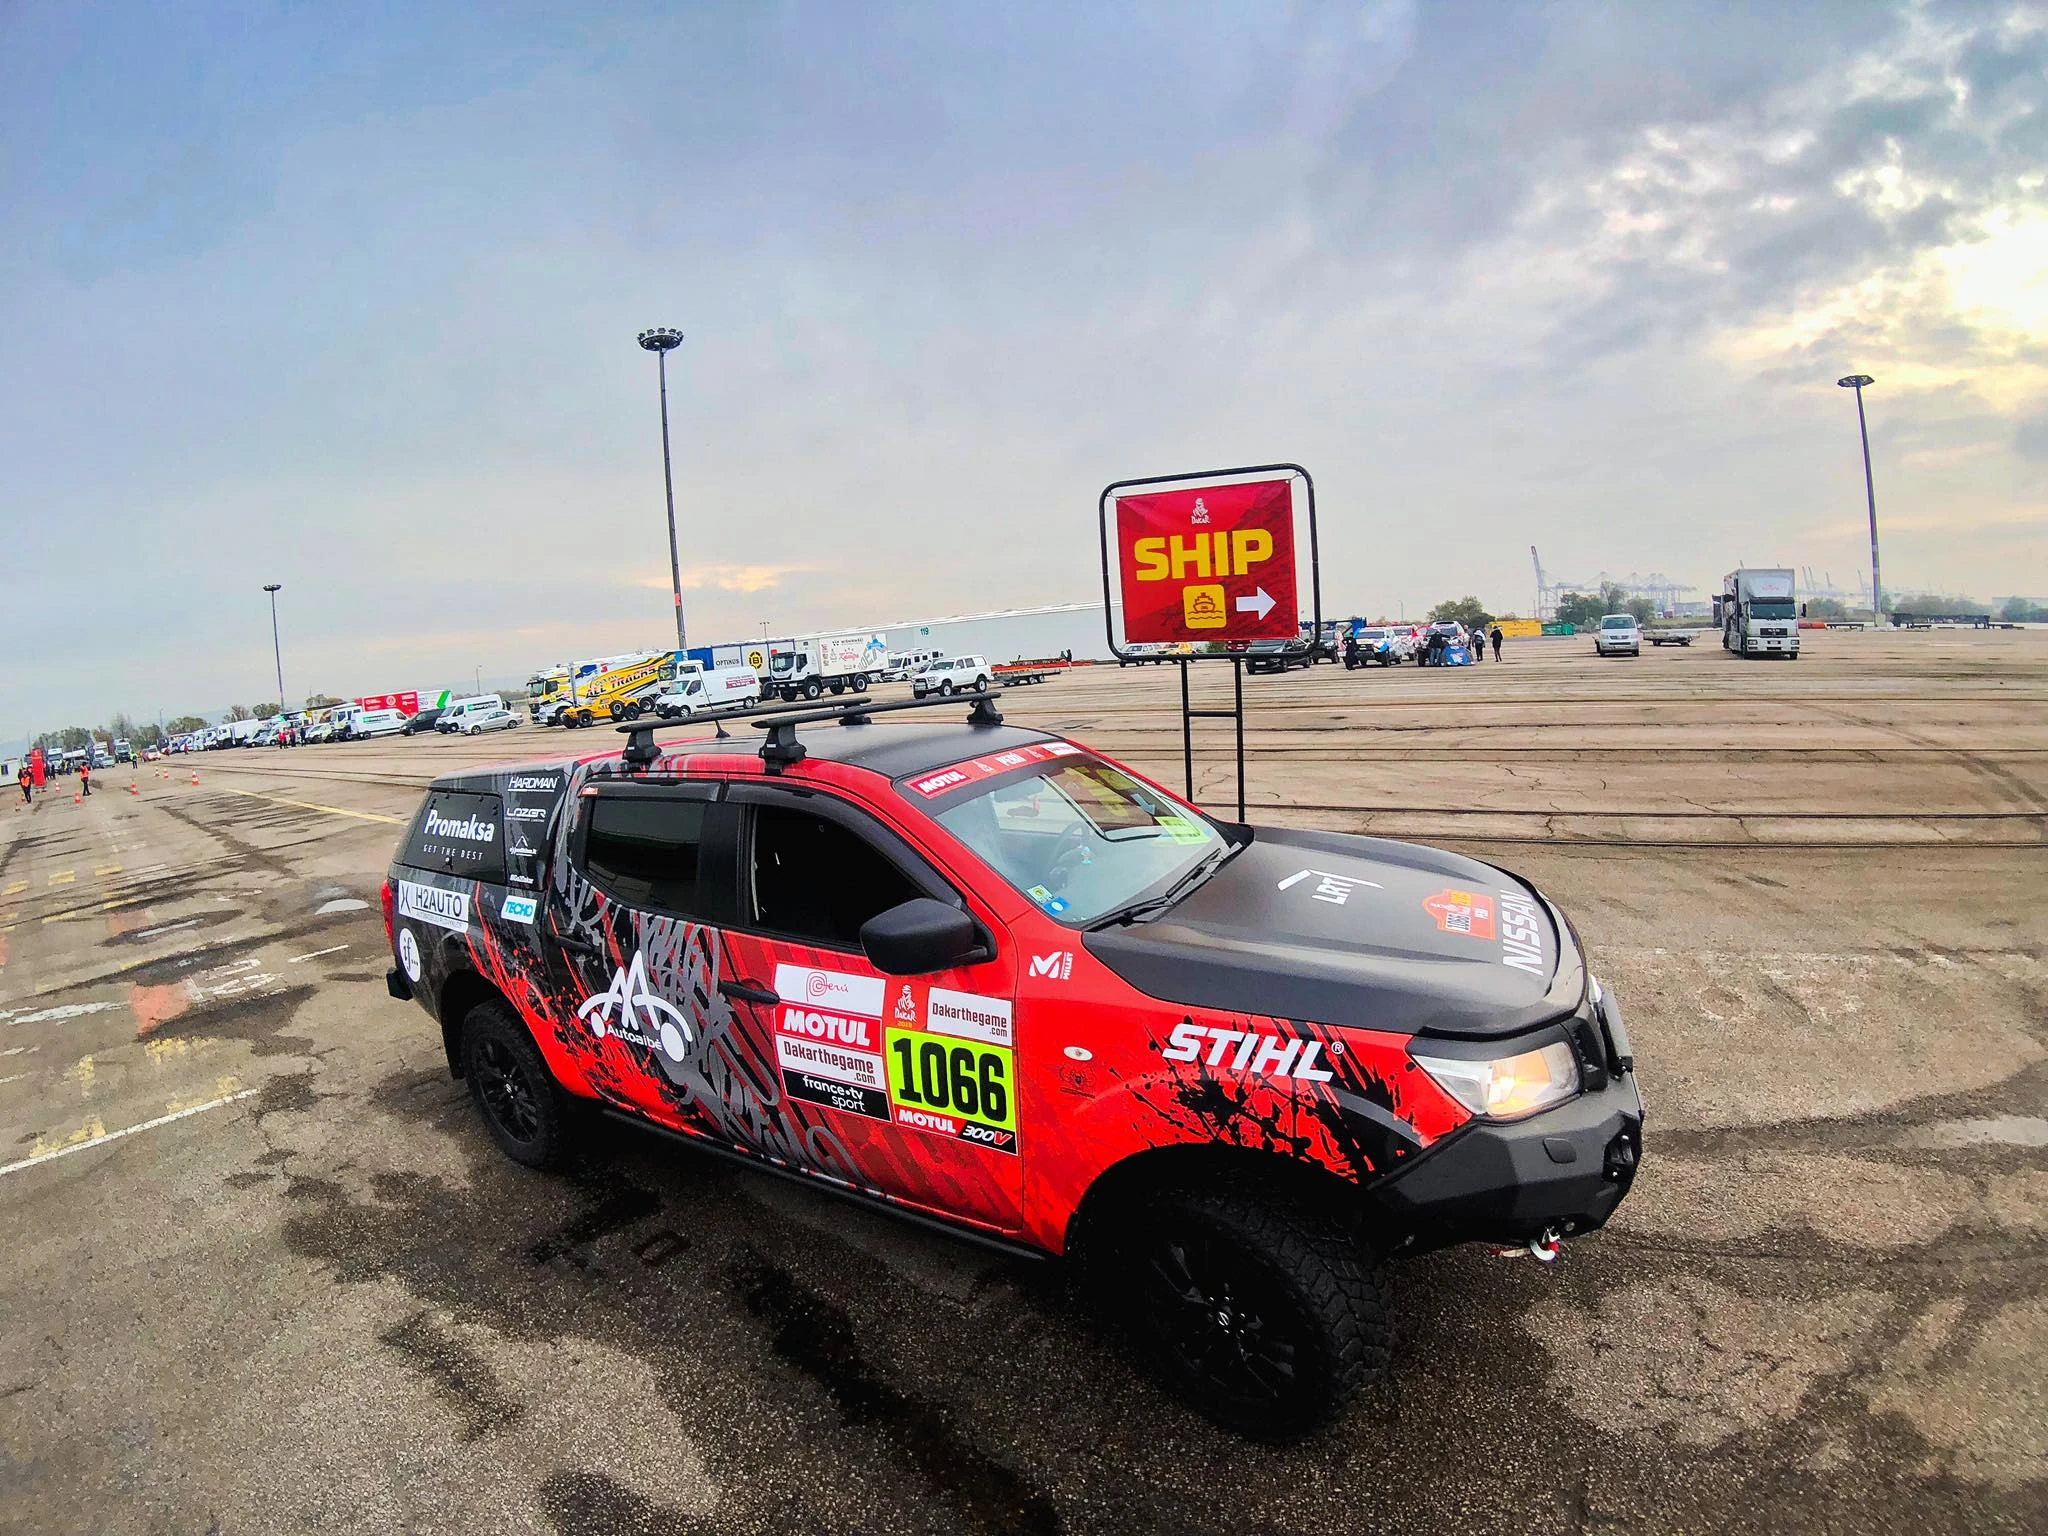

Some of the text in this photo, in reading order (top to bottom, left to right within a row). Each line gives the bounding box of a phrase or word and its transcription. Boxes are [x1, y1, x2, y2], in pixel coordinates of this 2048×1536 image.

[1134, 528, 1273, 581] SHIP
[920, 627, 930, 636] 119
[508, 776, 554, 790] HARDMAN
[917, 770, 967, 794] MOTUL
[424, 808, 495, 842] Promaksa
[423, 844, 483, 861] GET THE BEST
[415, 886, 463, 917] H2AUTO
[1312, 877, 1357, 905] LRT
[505, 900, 534, 917] TECHO
[1499, 888, 1545, 977] NISSAN
[783, 1008, 871, 1046] MOTUL
[932, 1002, 1007, 1028] Dakarthegame
[989, 1026, 1008, 1038] .com
[783, 1040, 875, 1075] Dakarthegame
[853, 1071, 876, 1086] .com
[892, 1037, 1007, 1123] 1066
[831, 1095, 866, 1113] sport
[898, 1108, 1013, 1146] MOTUL 300V
